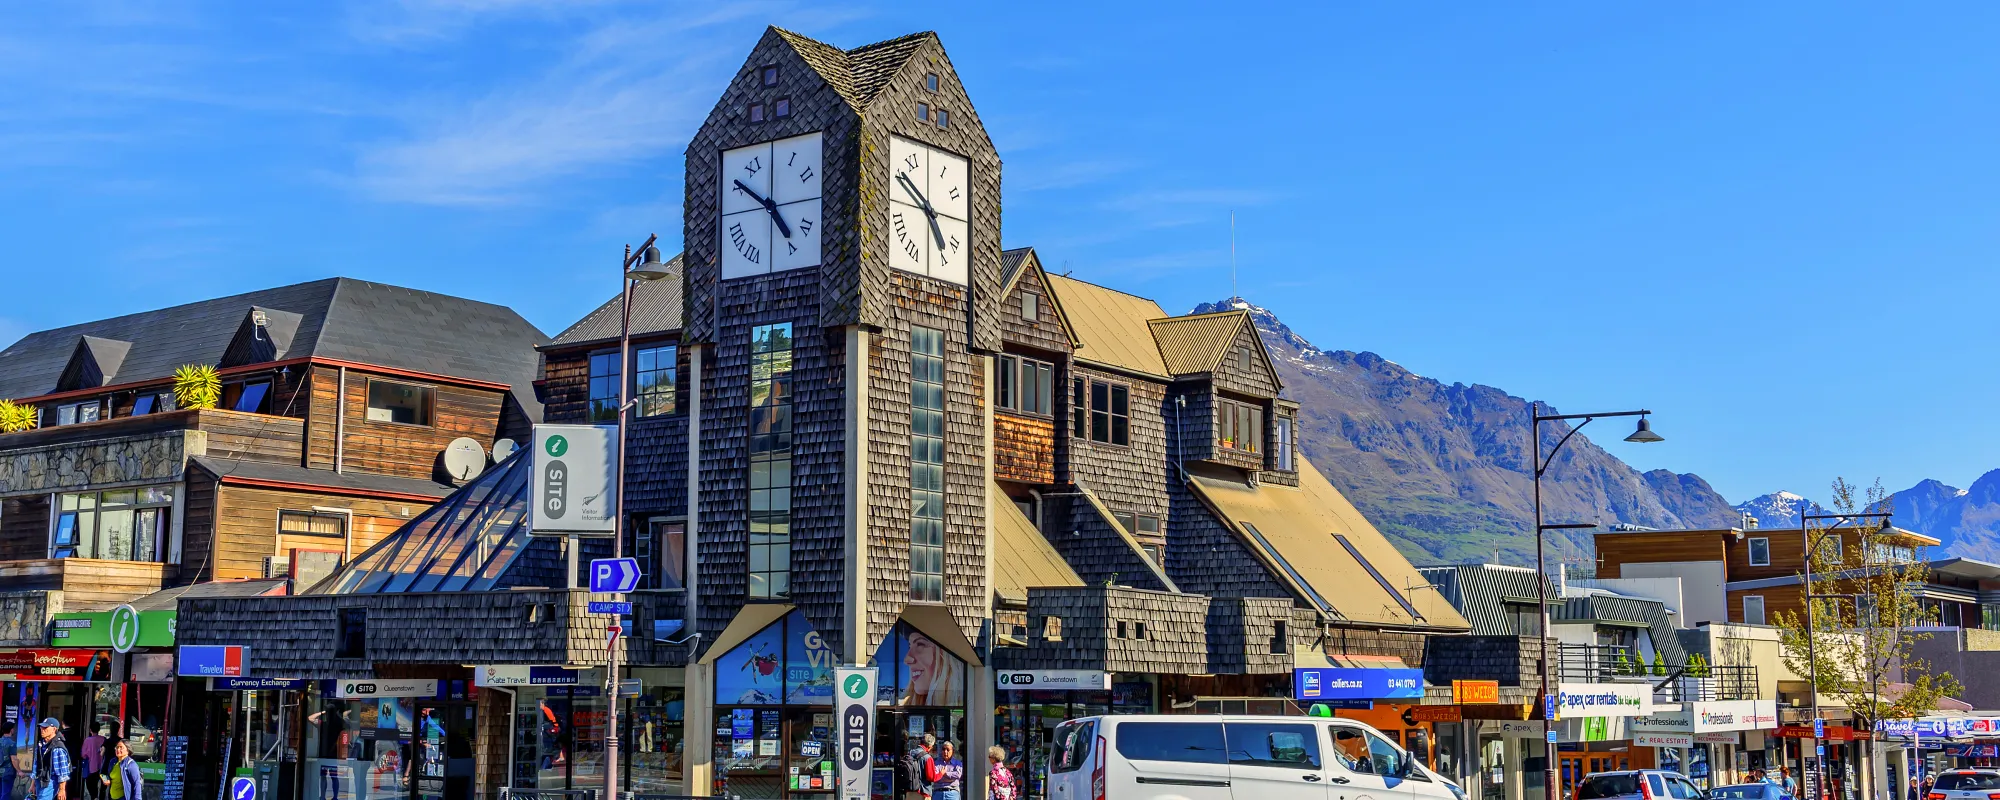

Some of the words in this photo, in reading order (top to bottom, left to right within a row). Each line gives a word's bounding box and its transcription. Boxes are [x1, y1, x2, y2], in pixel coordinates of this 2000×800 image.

[597, 564, 612, 588] P
[594, 604, 614, 612] CAMP
[616, 604, 625, 612] ST
[41, 667, 75, 675] cameras
[199, 664, 223, 674] Travelex
[230, 679, 259, 687] Currency
[261, 679, 290, 687] Exchange
[507, 675, 526, 683] Travel
[1042, 675, 1077, 683] Queenstown
[1332, 679, 1362, 688] colliers.co.nz
[1388, 679, 1394, 688] 03
[1568, 693, 1585, 709] apex
[1585, 694, 1596, 705] car
[1597, 691, 1617, 705] rentals
[1644, 716, 1689, 726] Professionals
[1708, 712, 1733, 725] Professionals
[1513, 725, 1532, 733] apex
